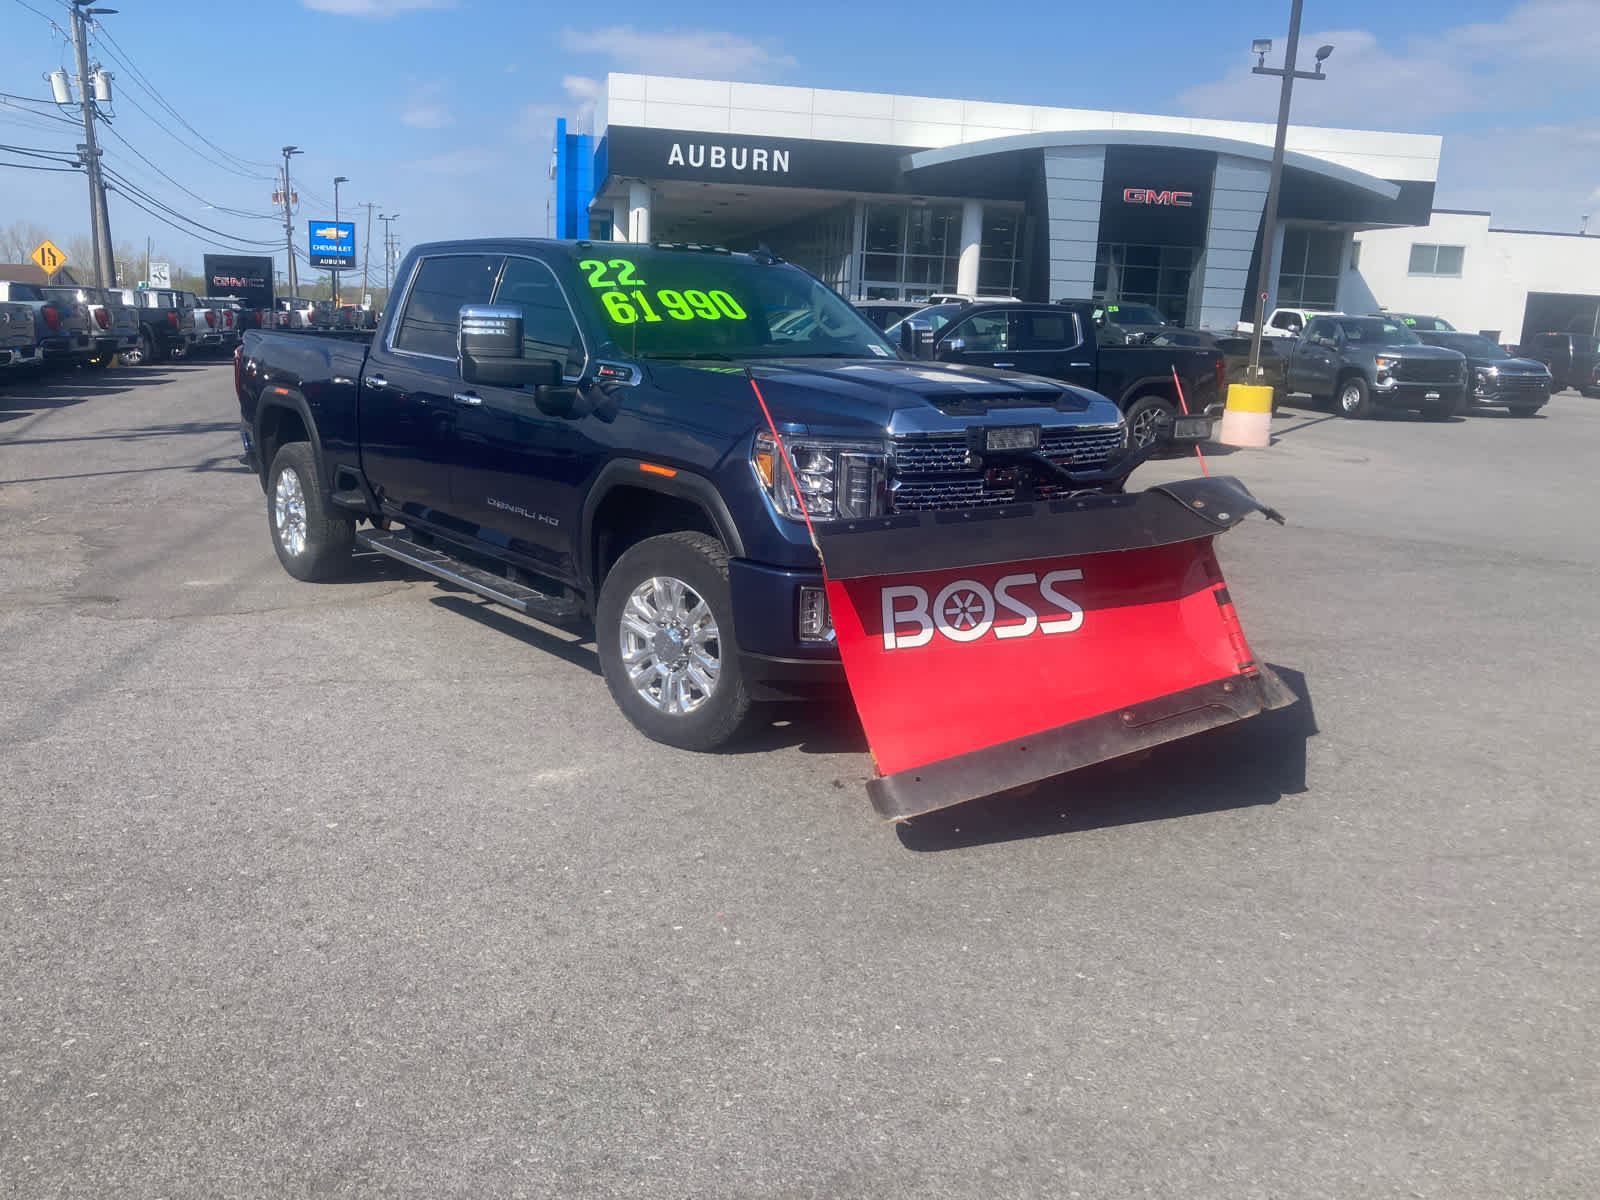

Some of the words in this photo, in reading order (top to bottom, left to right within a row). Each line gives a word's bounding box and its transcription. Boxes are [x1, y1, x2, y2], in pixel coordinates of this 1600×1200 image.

[667, 143, 790, 172] AUBURN
[1123, 188, 1193, 207] GMC
[213, 275, 265, 288] GMC
[579, 259, 648, 288] 22
[881, 568, 1084, 650] BOSS
